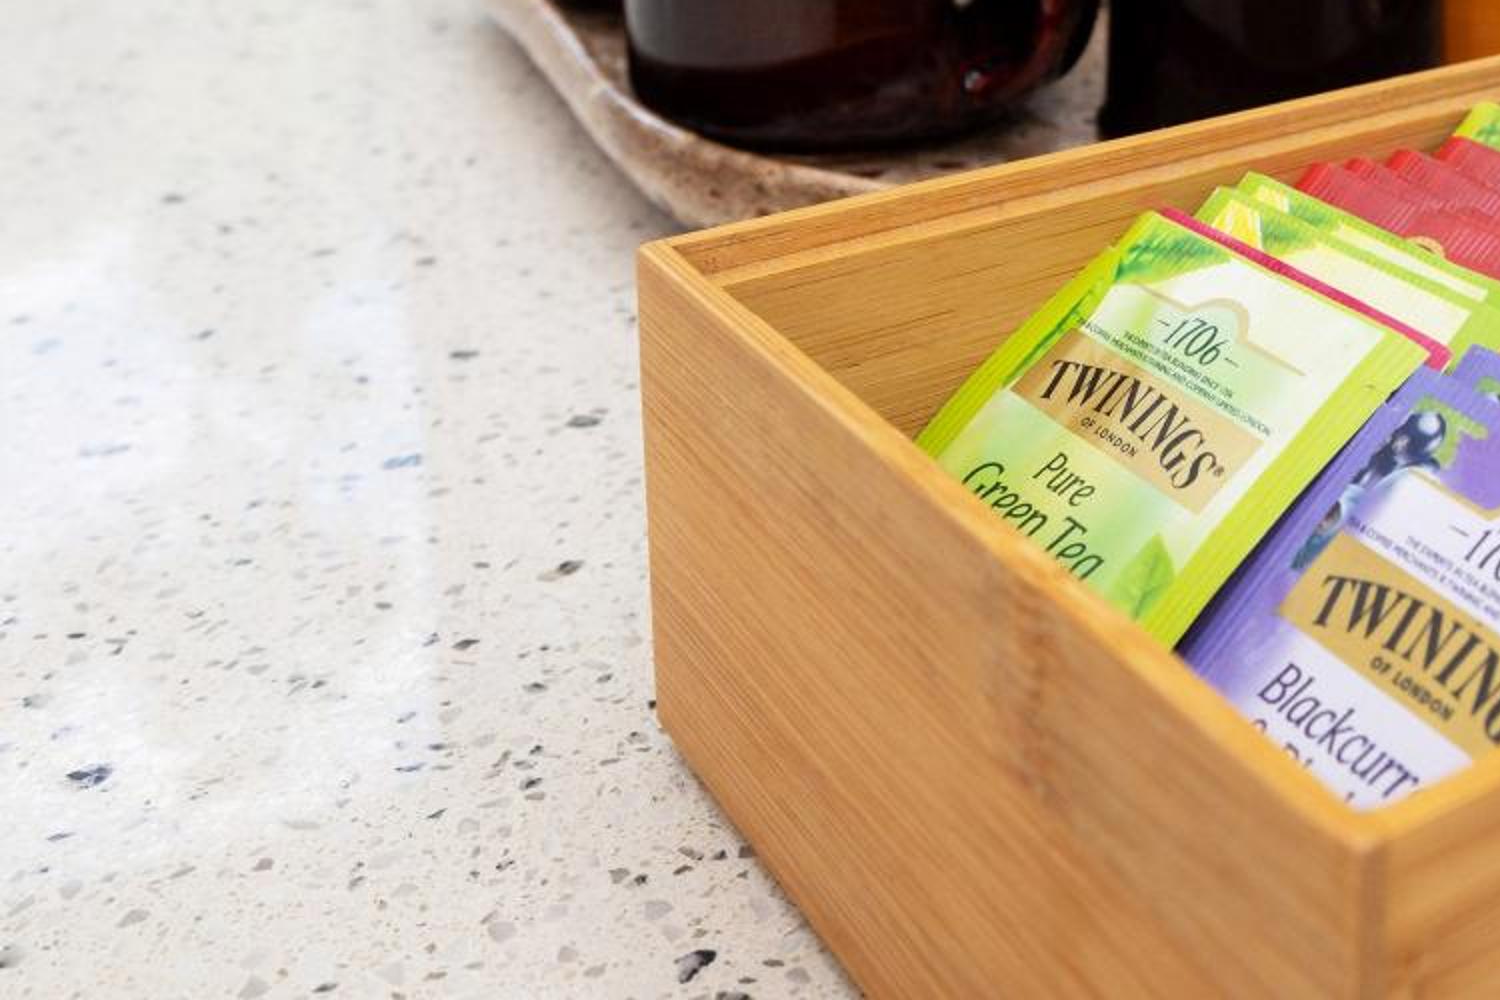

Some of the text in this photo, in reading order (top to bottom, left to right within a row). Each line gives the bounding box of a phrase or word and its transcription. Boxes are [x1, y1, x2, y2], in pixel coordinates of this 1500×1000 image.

[1080, 416, 1138, 458] OF LONDON
[1032, 451, 1096, 507] Pure
[961, 461, 1105, 581] Green Tea
[1369, 656, 1456, 722] OF LONDON
